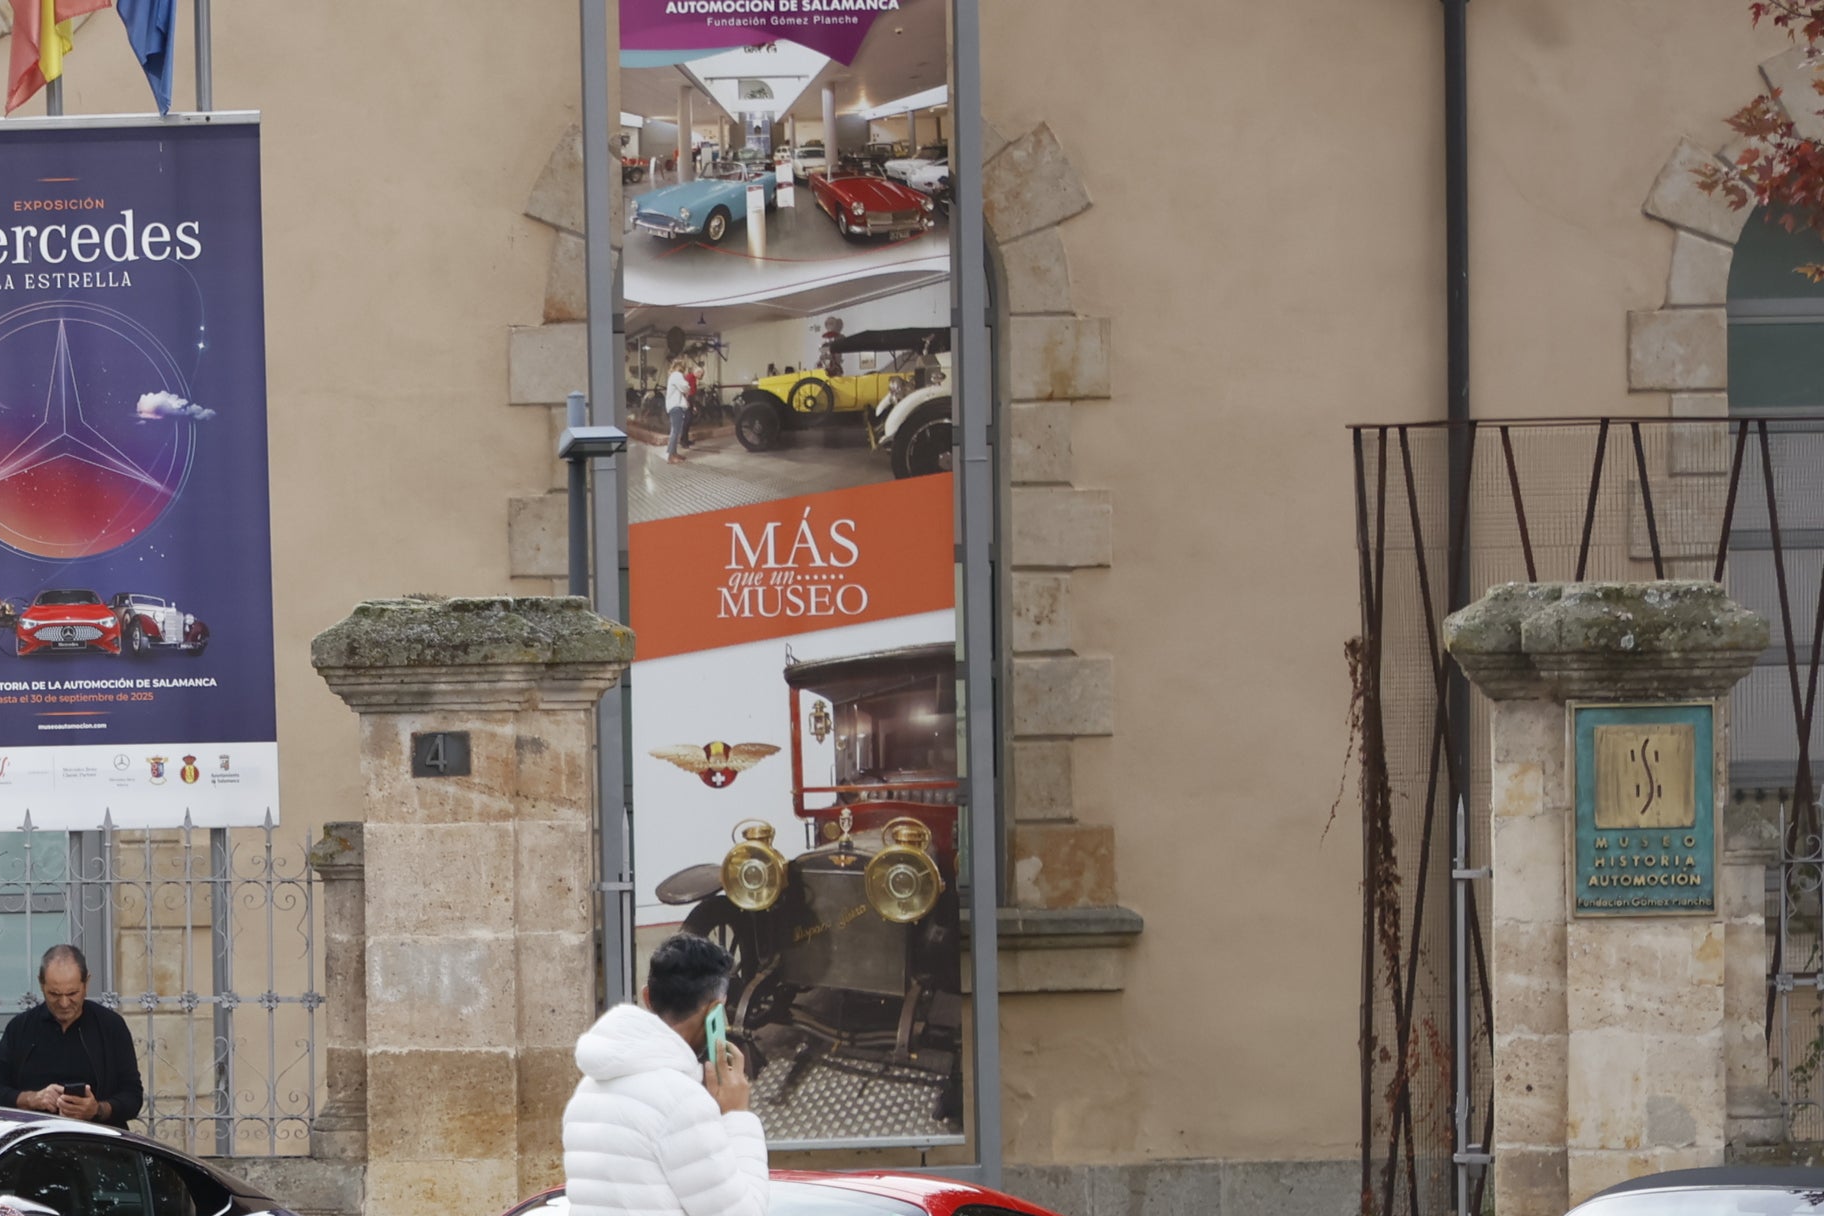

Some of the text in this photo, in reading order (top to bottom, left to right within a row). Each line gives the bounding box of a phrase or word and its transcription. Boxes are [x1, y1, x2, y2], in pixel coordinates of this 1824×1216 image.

[779, 0, 798, 12] DE
[802, 0, 900, 11] SALAMANCA
[707, 15, 858, 26] Fundación Gómez Planche
[13, 197, 105, 212] EXPOSICIÓN
[25, 271, 132, 290] ESTRELLA
[725, 506, 860, 569] MÁS
[728, 570, 764, 593] que
[717, 584, 869, 619] MUSEO
[31, 681, 46, 690] DE
[48, 680, 62, 690] LA
[64, 677, 134, 689] AUTOMOCIÓN
[136, 679, 150, 688] DE
[152, 677, 217, 688] SALAMANCA
[19, 694, 28, 703] el
[30, 694, 43, 703] 30
[44, 694, 57, 703] de
[59, 692, 114, 704] septiembre
[116, 692, 129, 701] de
[131, 692, 154, 701] 2025
[426, 734, 447, 773] 4
[1595, 835, 1696, 849] MUSEO
[1594, 855, 1696, 868] HISTORIA
[1588, 867, 1702, 887] AUTOMOCIÓN
